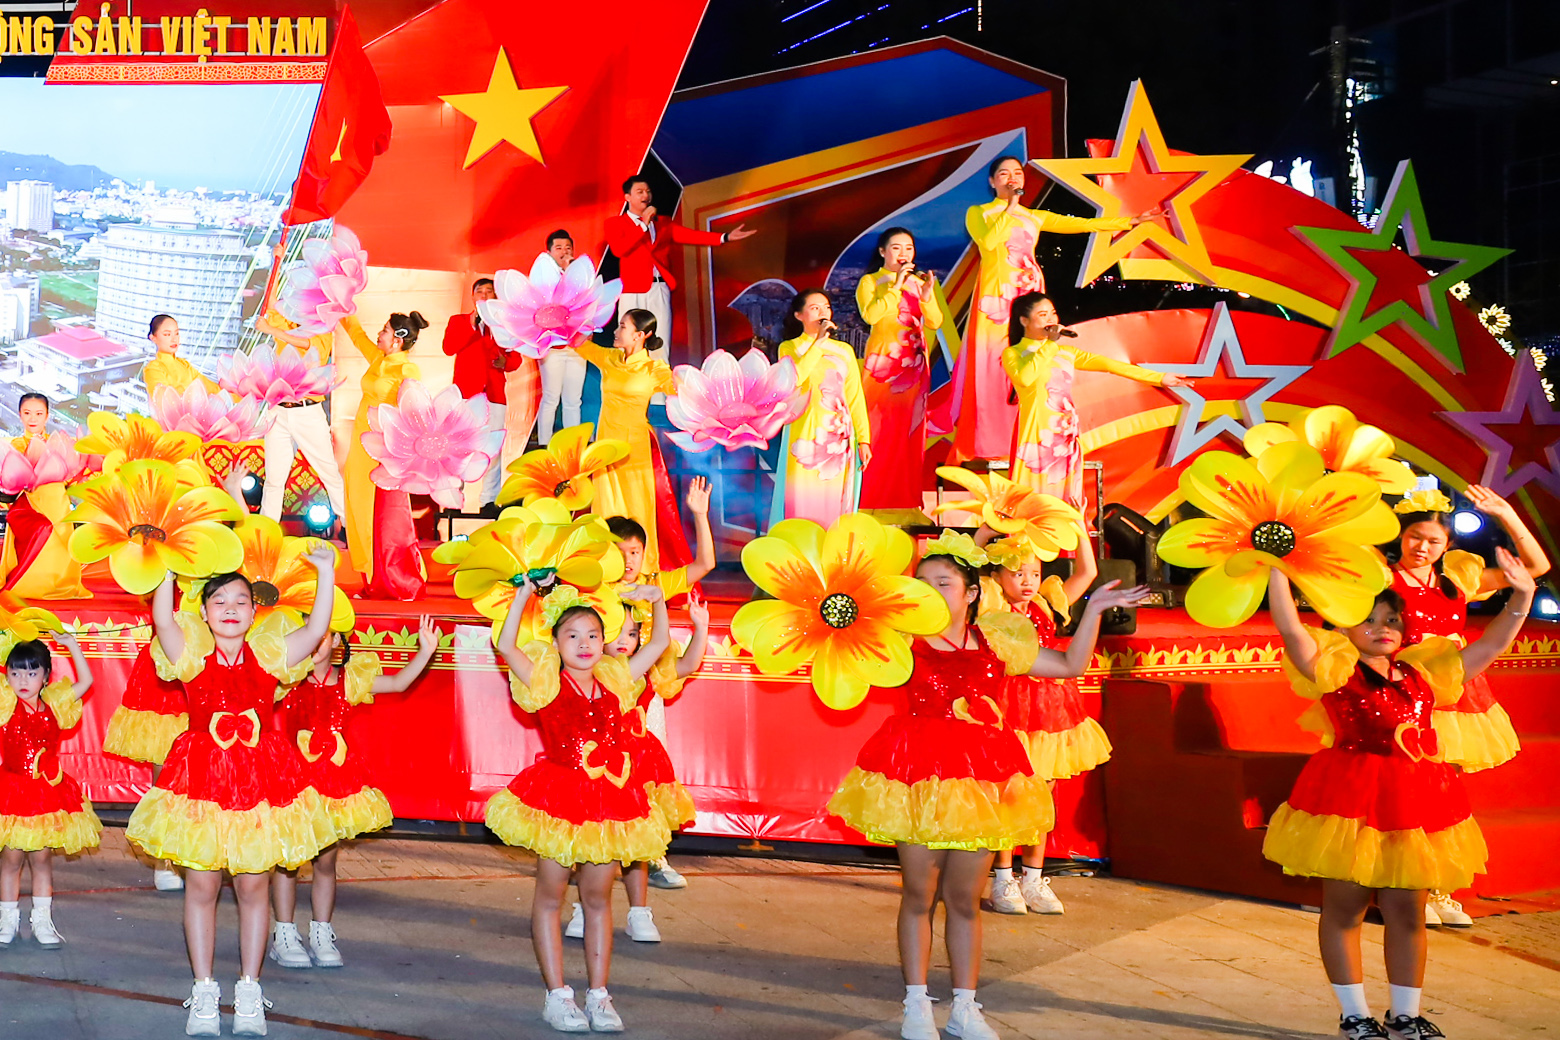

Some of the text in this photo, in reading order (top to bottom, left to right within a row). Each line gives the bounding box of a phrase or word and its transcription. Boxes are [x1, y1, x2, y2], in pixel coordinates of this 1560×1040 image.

[72, 2, 142, 56] SẢN
[160, 8, 232, 63] VIỆT
[247, 16, 327, 56] NAM
